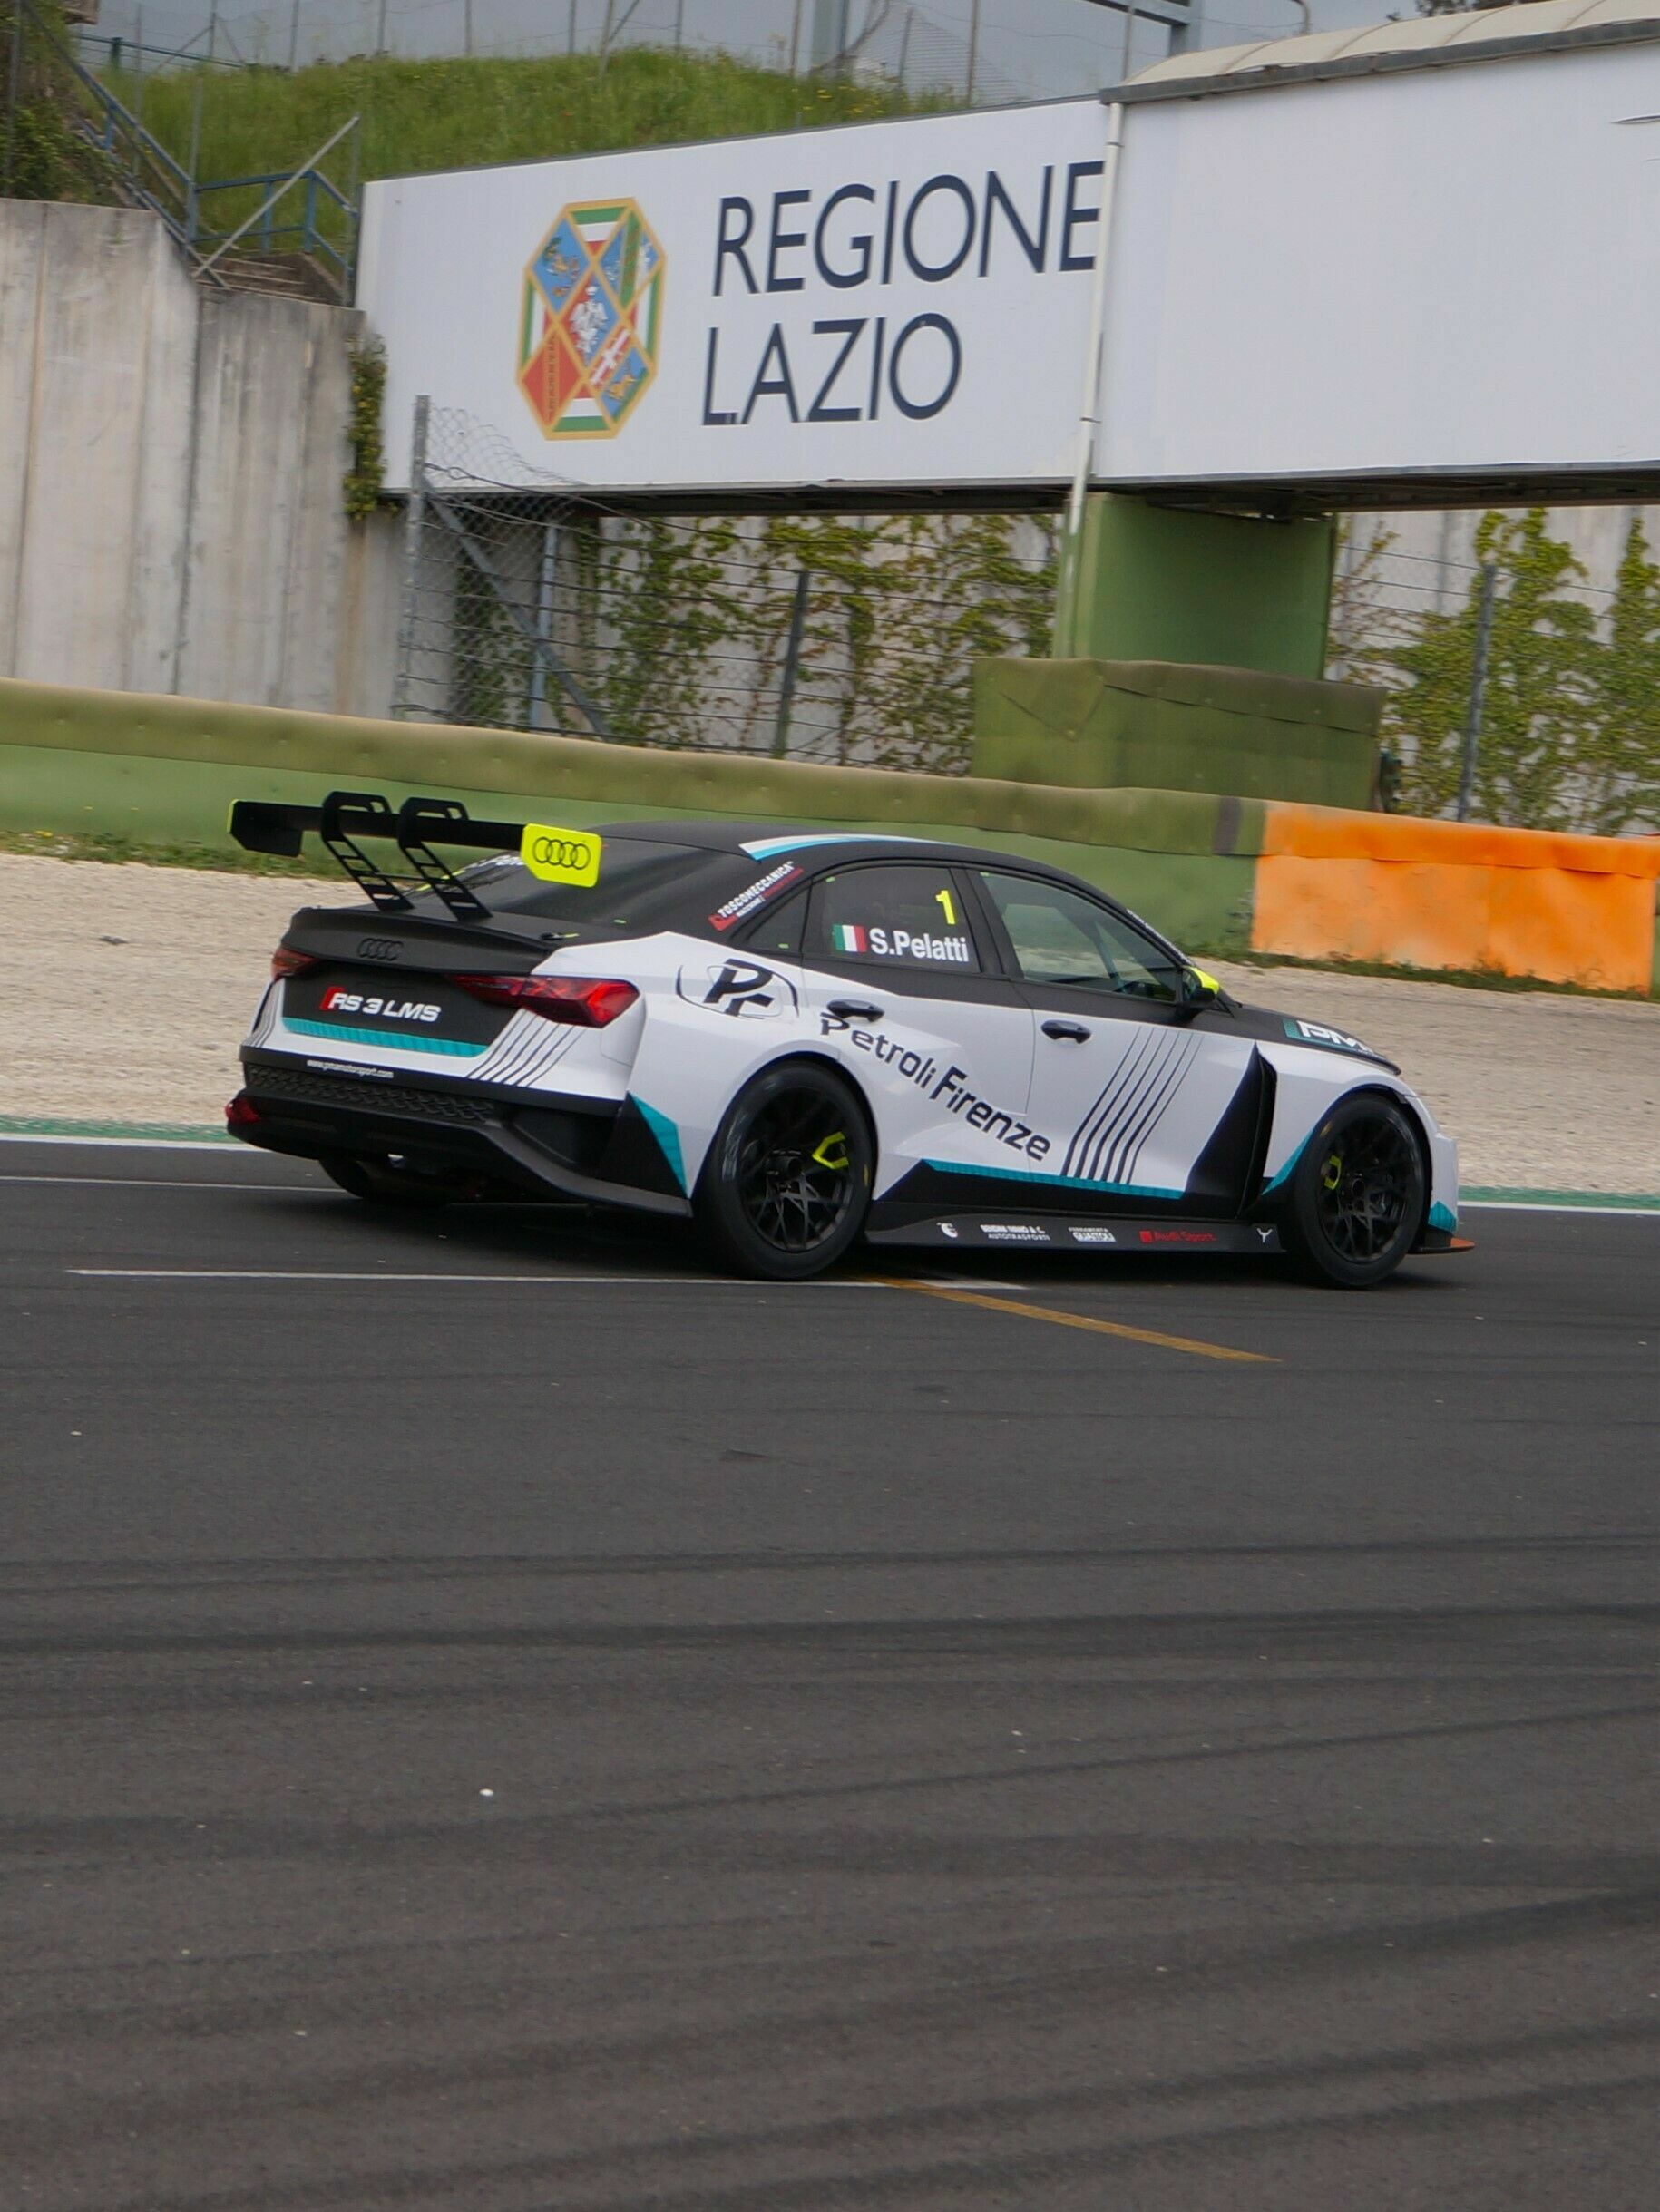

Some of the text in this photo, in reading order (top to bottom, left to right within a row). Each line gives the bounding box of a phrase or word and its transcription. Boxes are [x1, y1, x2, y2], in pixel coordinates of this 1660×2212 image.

[712, 161, 1104, 297] REGIONE
[702, 313, 962, 425] LAZIO
[934, 890, 956, 925] 1
[868, 927, 970, 963] S.Pelatti
[327, 992, 442, 1022] RS 3 LMS
[819, 1012, 1051, 1162] Petroli Firenze
